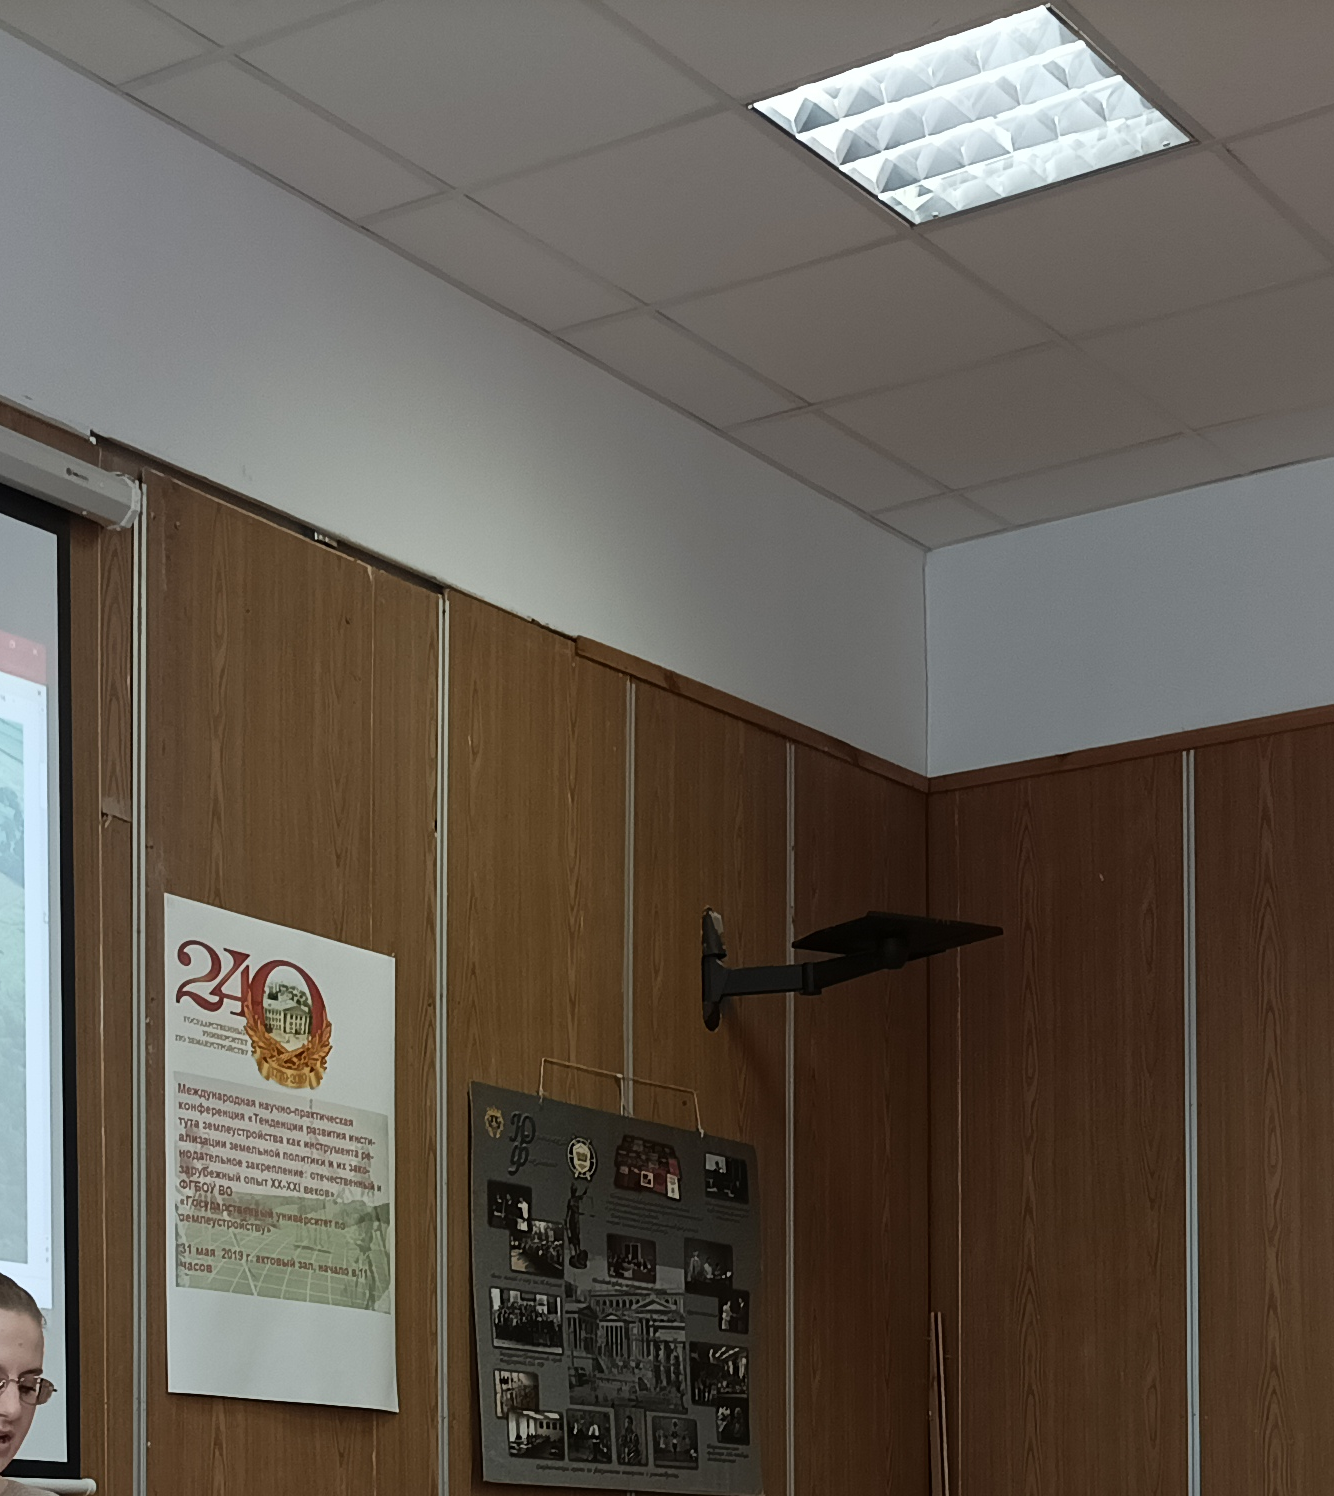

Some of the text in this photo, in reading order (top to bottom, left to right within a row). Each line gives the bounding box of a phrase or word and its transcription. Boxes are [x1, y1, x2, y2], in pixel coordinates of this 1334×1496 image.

[176, 940, 328, 1042] 240
[178, 1083, 354, 1128] Международная научно-практическая
[178, 1100, 245, 1122] конференция
[248, 1113, 304, 1134] «Тенденции
[306, 1126, 347, 1141] развития
[178, 1116, 200, 1130] тута
[202, 1121, 284, 1145] землеустройства
[286, 1137, 302, 1148] как
[304, 1139, 364, 1160] инструмента
[178, 1132, 227, 1149] ализации
[229, 1140, 281, 1159] земельной
[283, 1152, 326, 1168] политики
[328, 1159, 334, 1168] и
[337, 1160, 347, 1171] их
[179, 1149, 243, 1168] нодательное
[310, 1171, 375, 1191] отечественный
[179, 1163, 242, 1183] зарубежный
[244, 1175, 268, 1187] опыт
[304, 1185, 335, 1198] веков»
[179, 1178, 233, 1196] ФГБОУ ВО
[179, 1213, 272, 1235] землеустройству»
[180, 1195, 346, 1231] «Государственный университет по
[180, 1243, 192, 1255] 31
[195, 1246, 216, 1258] мая
[221, 1248, 244, 1262] 2019
[255, 1254, 296, 1269] актовый
[318, 1263, 349, 1276] начало
[180, 1262, 213, 1274] часов
